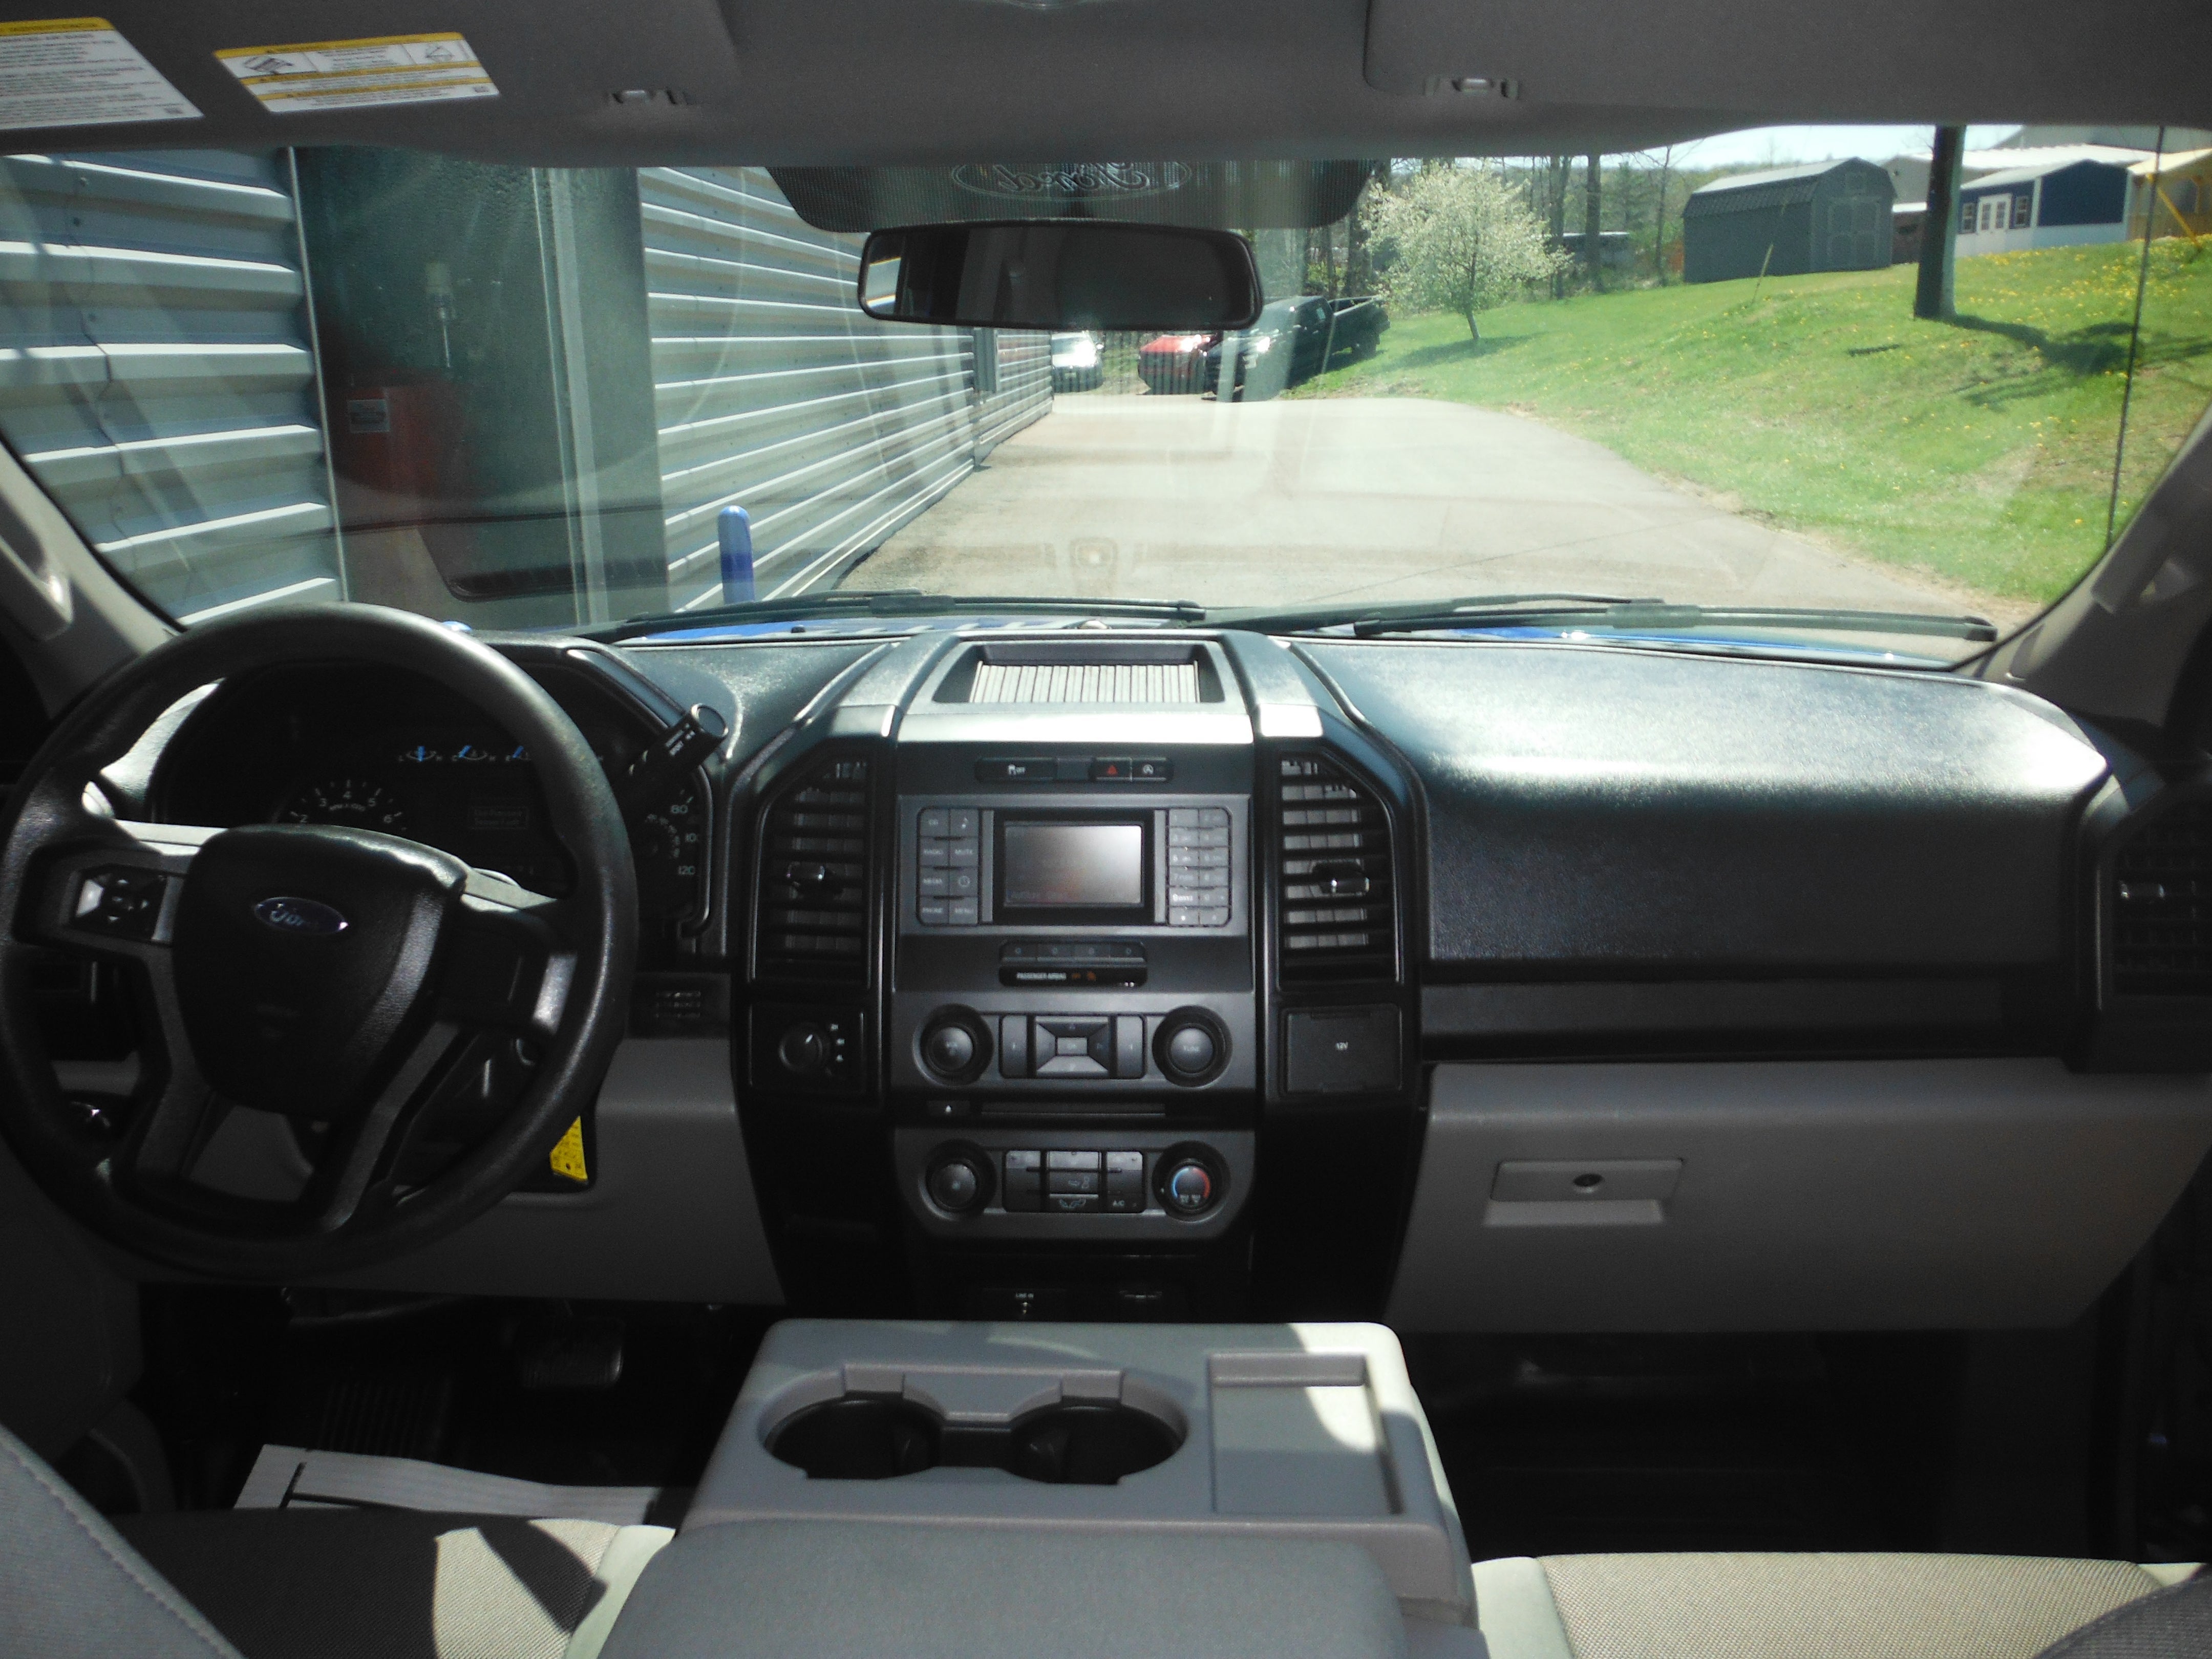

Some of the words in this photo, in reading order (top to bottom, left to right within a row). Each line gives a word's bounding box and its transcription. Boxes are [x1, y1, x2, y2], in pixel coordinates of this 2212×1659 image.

[343, 791, 352, 800] 4
[319, 797, 328, 807] 3
[367, 797, 376, 807] 5
[671, 804, 689, 814] 80
[300, 814, 308, 823] 2
[383, 814, 393, 824] 6
[677, 865, 696, 875] 120
[1016, 972, 1047, 980] PASSENGER
